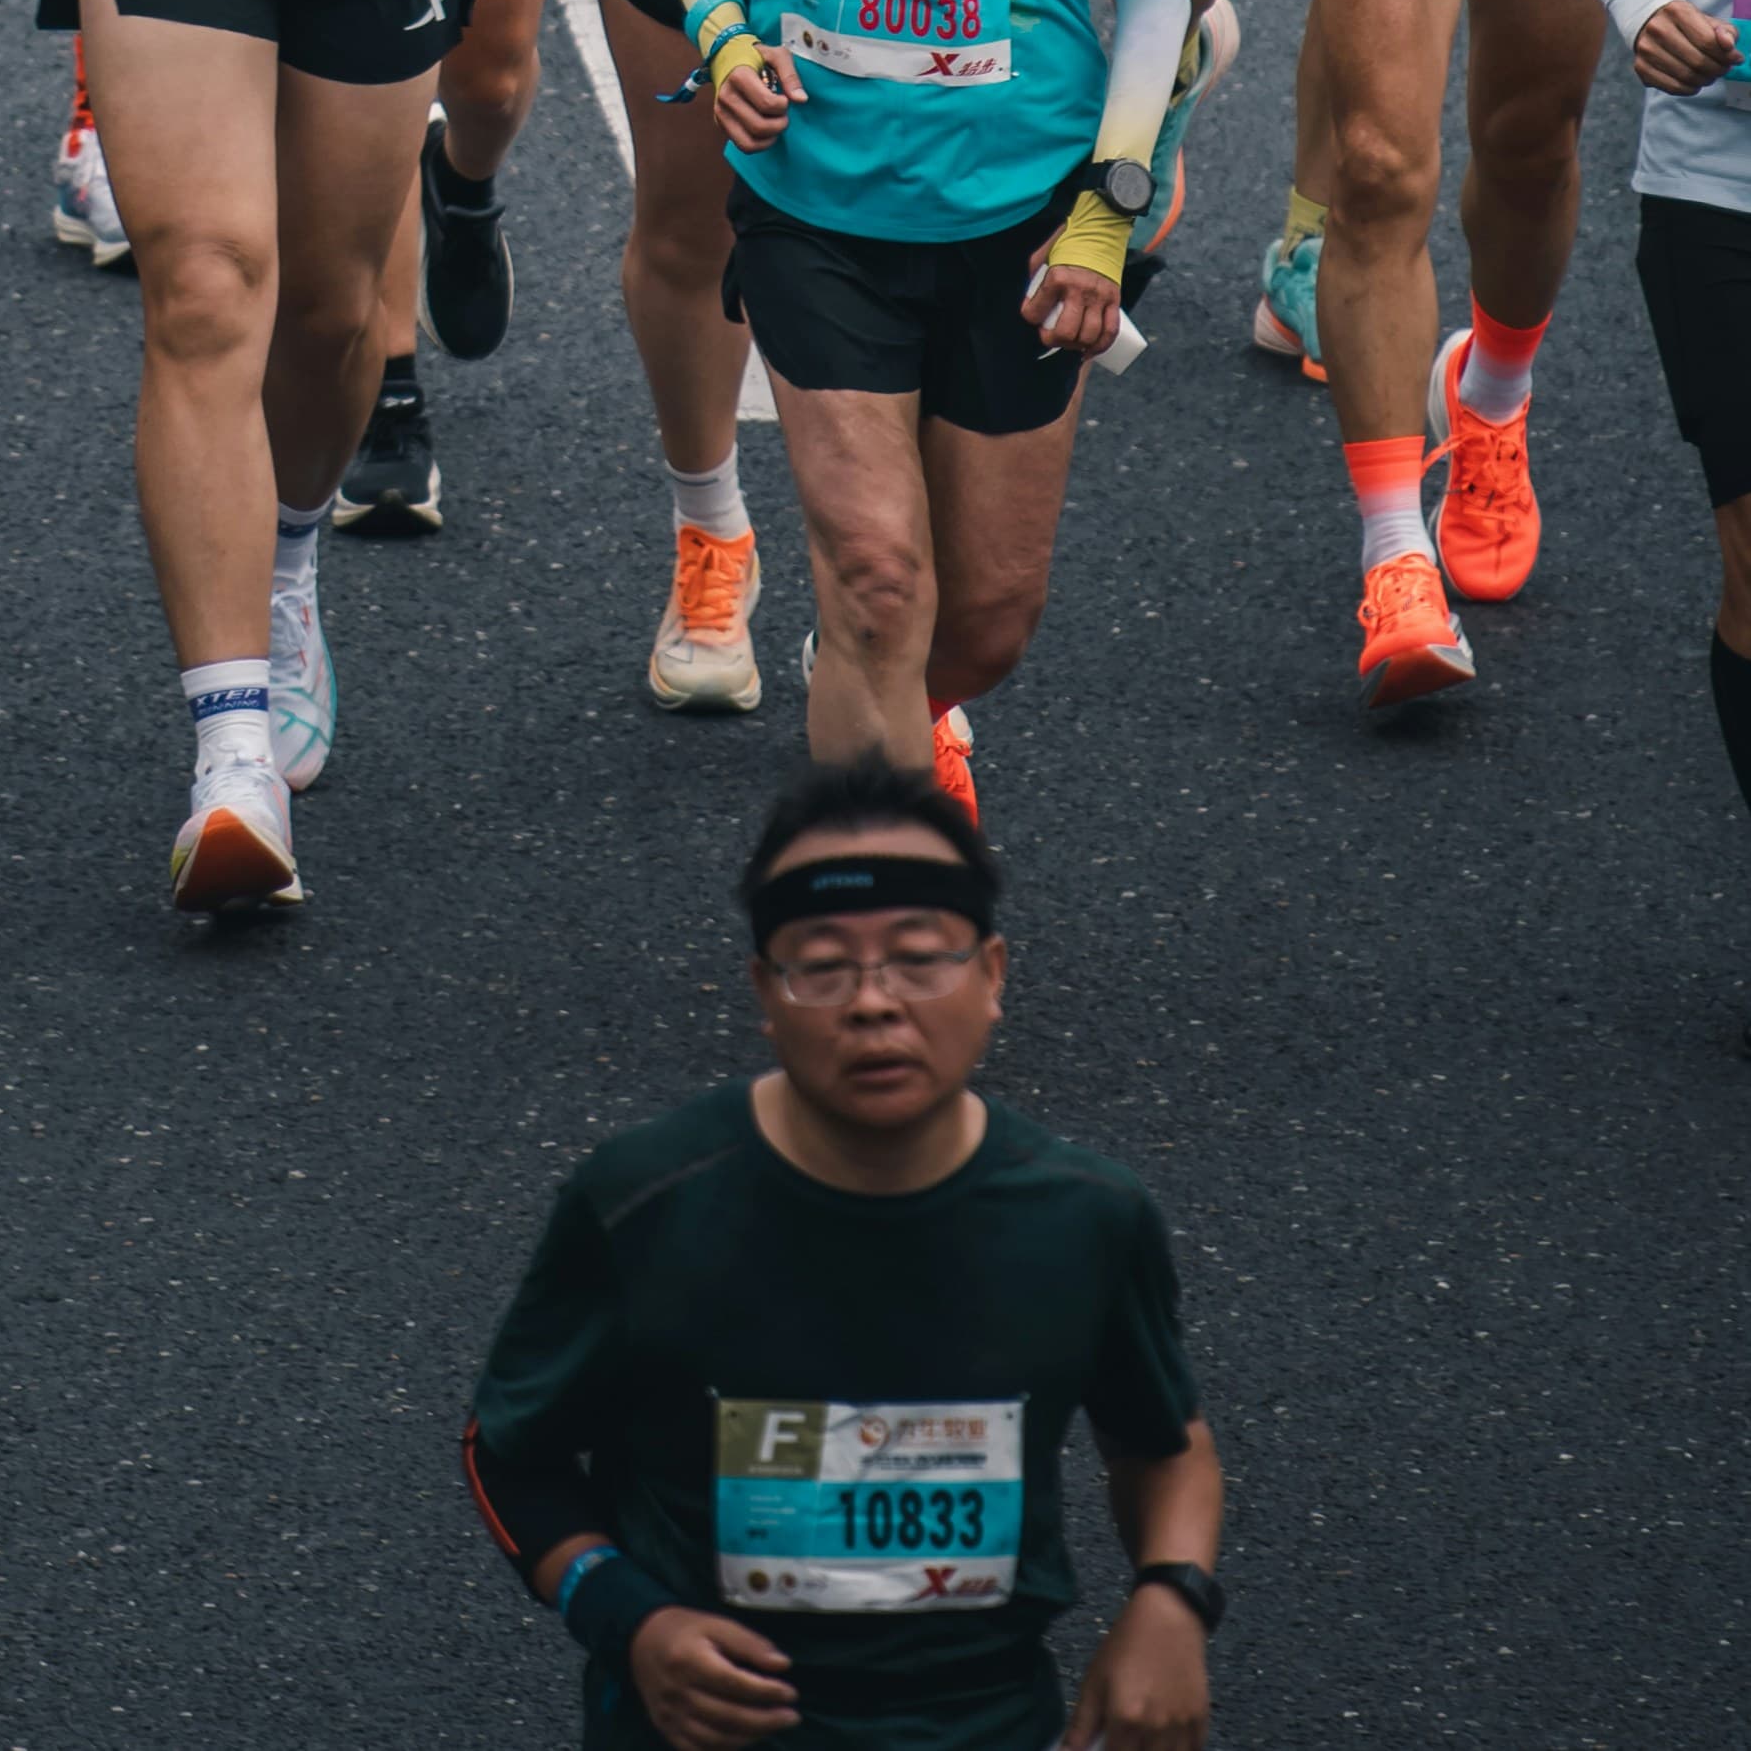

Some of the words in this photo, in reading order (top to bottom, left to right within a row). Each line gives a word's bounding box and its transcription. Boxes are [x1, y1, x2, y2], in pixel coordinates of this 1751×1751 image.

[195, 688, 261, 708] XTEP
[759, 1409, 807, 1462] F
[839, 1488, 985, 1551] 10833
